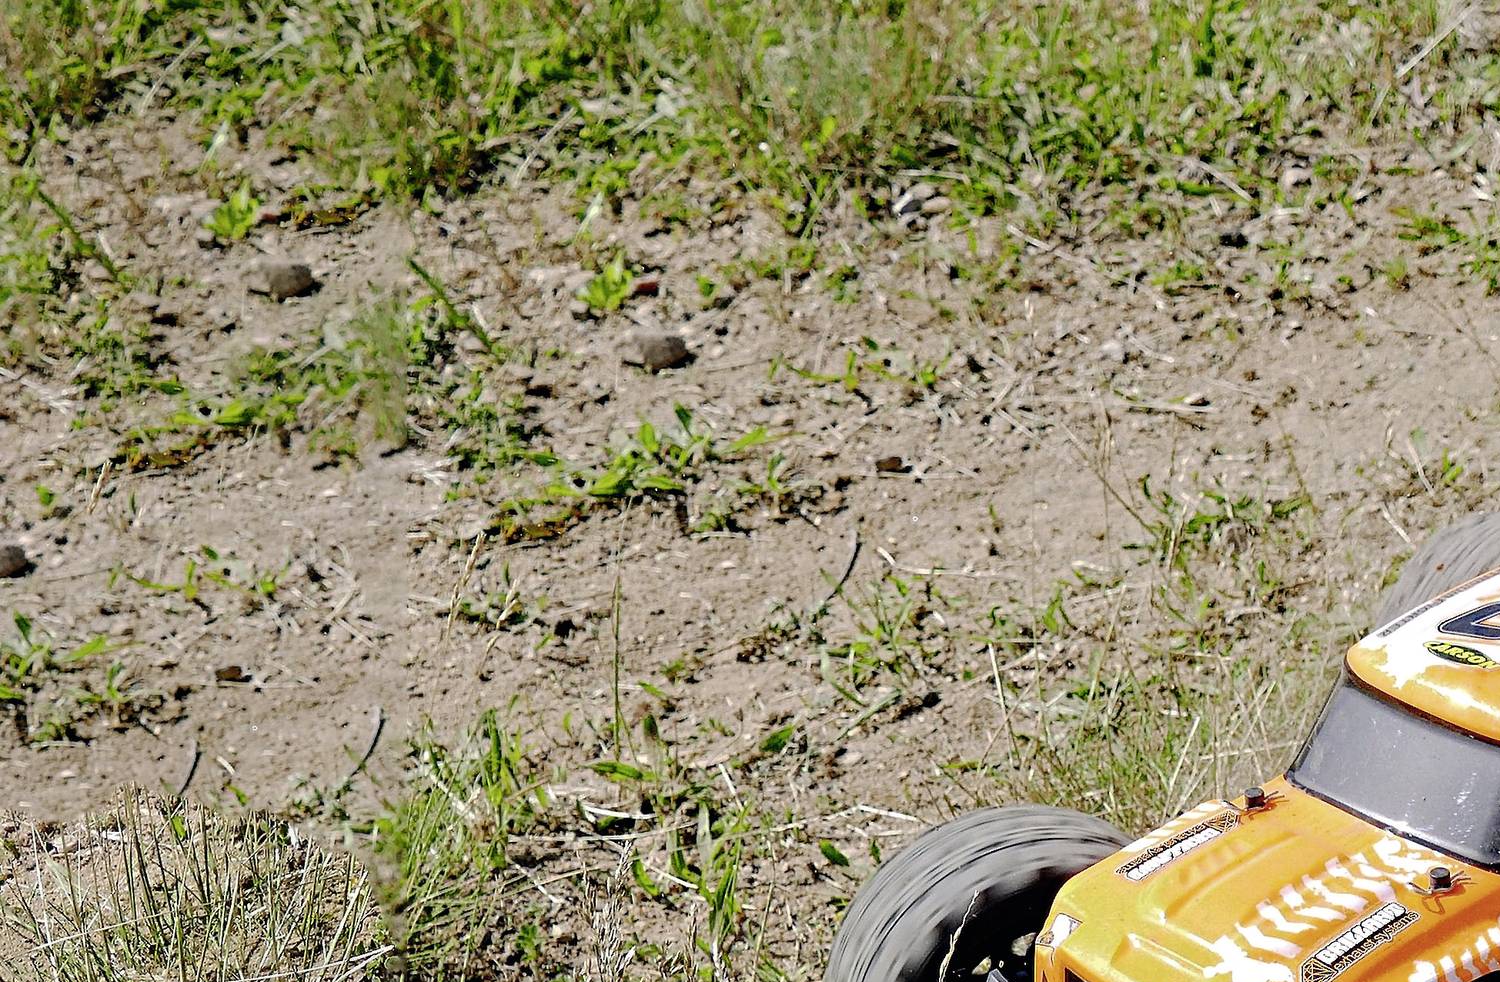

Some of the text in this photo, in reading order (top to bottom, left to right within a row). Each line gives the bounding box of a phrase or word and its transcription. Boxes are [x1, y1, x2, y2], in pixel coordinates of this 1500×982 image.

[1316, 902, 1407, 965] BRILLANT
[1333, 909, 1420, 972] exhaust systems
